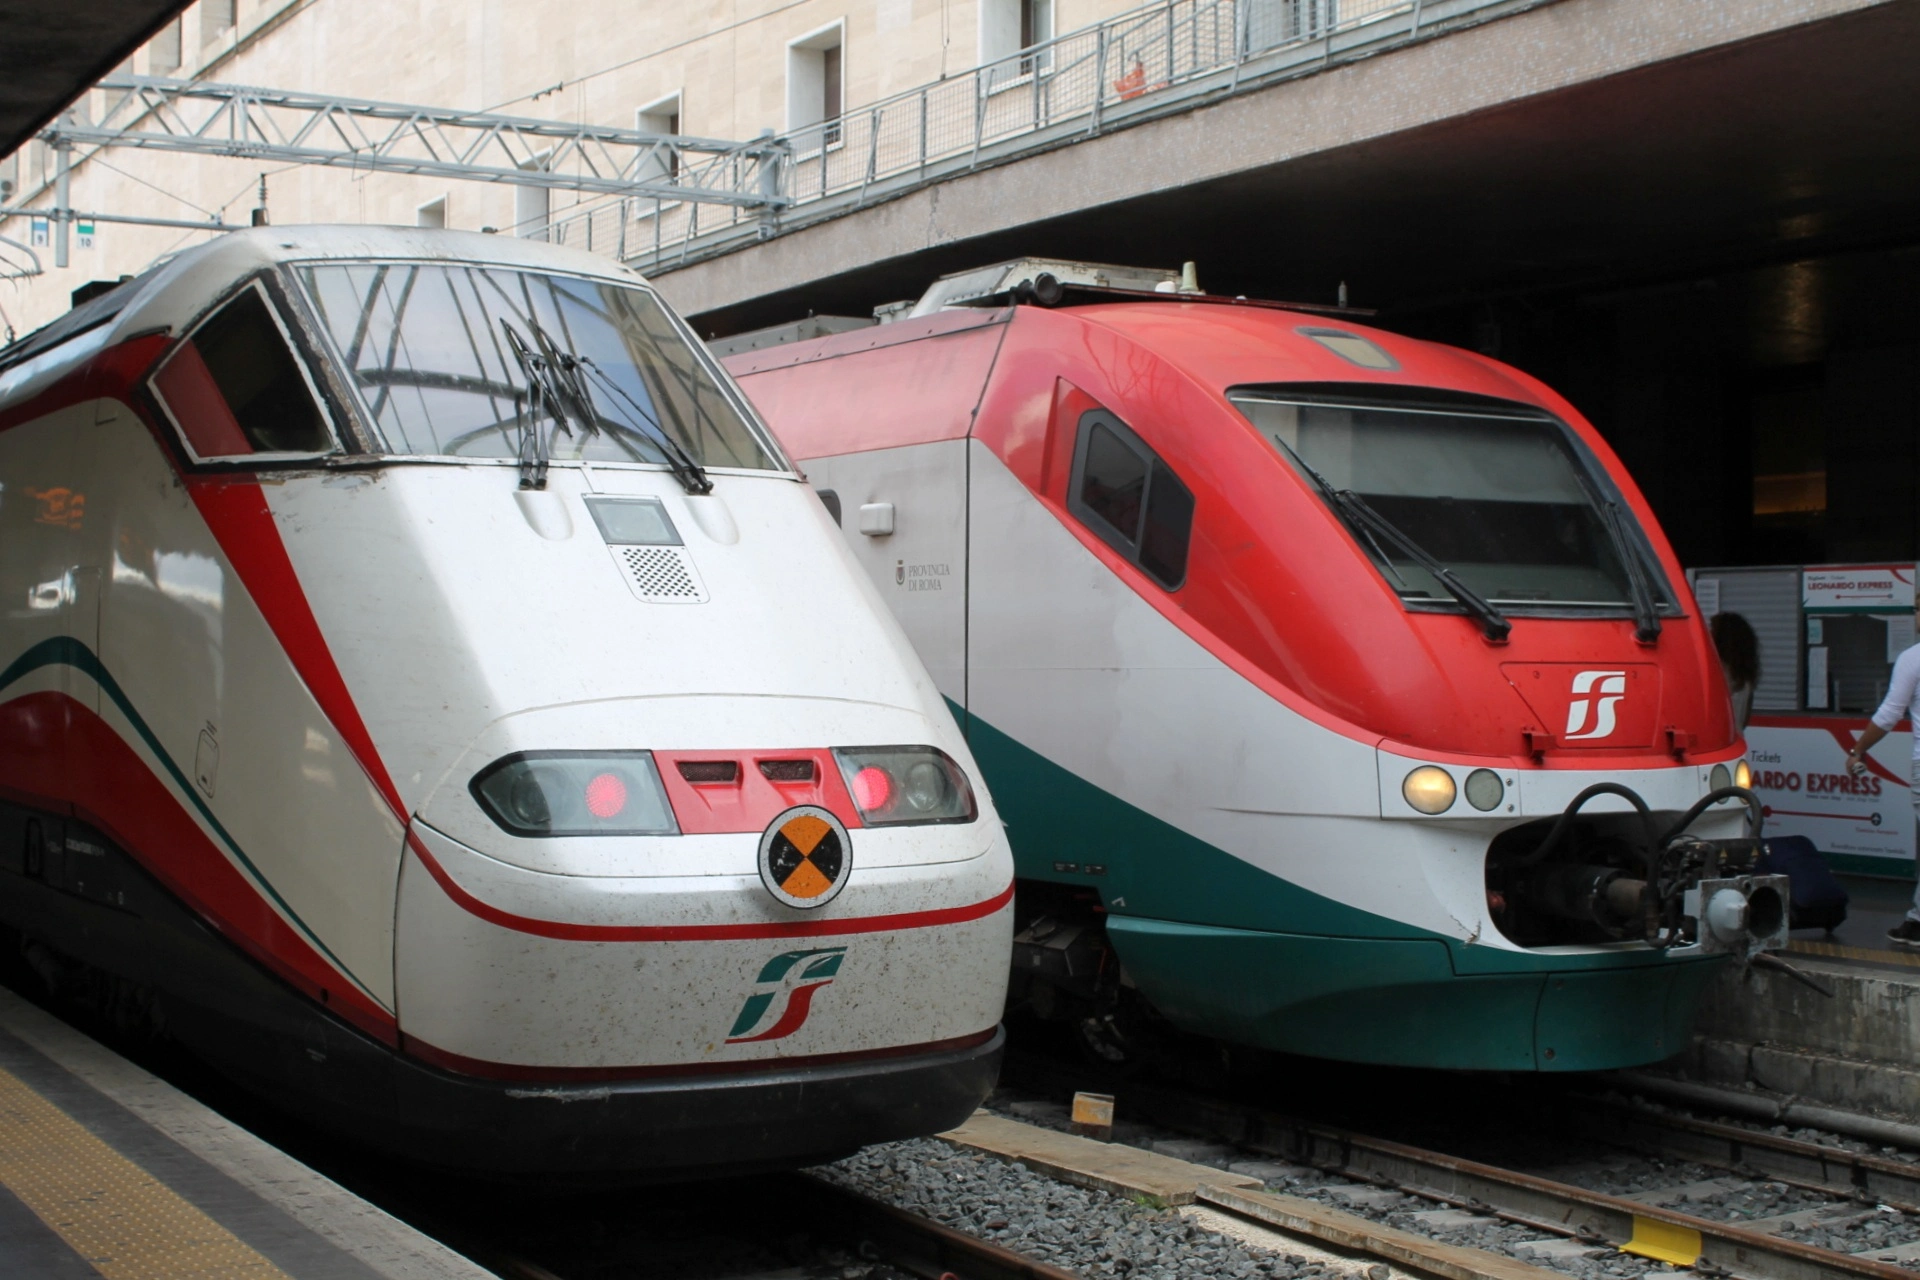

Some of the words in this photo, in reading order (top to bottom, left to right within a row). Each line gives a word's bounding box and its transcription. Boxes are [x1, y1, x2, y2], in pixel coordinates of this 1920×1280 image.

[80, 237, 92, 247] 10
[908, 564, 950, 577] PROVINCIA
[908, 579, 917, 592] DI
[919, 579, 942, 591] ROMA
[1808, 581, 1855, 590] LEONARDO
[1857, 581, 1893, 589] EXPRESS
[1751, 750, 1781, 764] Tickets
[1807, 773, 1882, 797] EXPRESS
